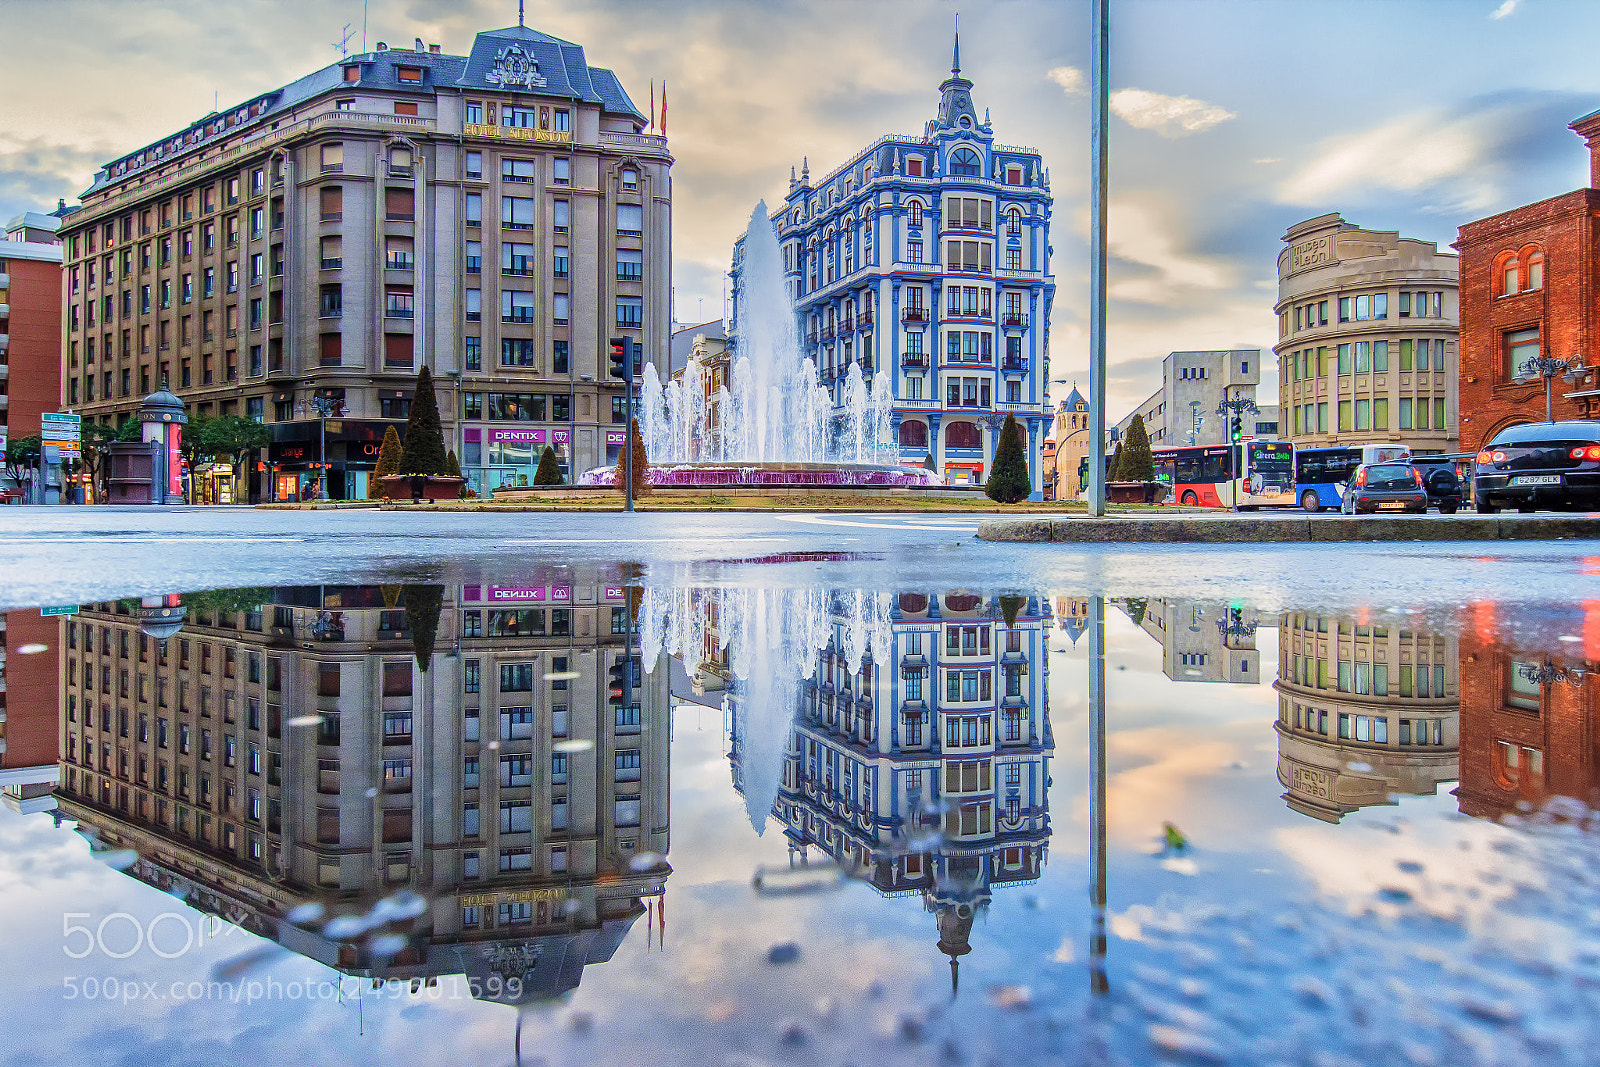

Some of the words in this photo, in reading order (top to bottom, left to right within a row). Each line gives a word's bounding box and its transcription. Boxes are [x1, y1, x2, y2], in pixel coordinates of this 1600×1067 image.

[464, 123, 499, 136] HOTEL
[1294, 239, 1326, 256] museo
[1300, 250, 1326, 267] León
[495, 432, 538, 440] DENTIX
[1519, 476, 1540, 484] 6287
